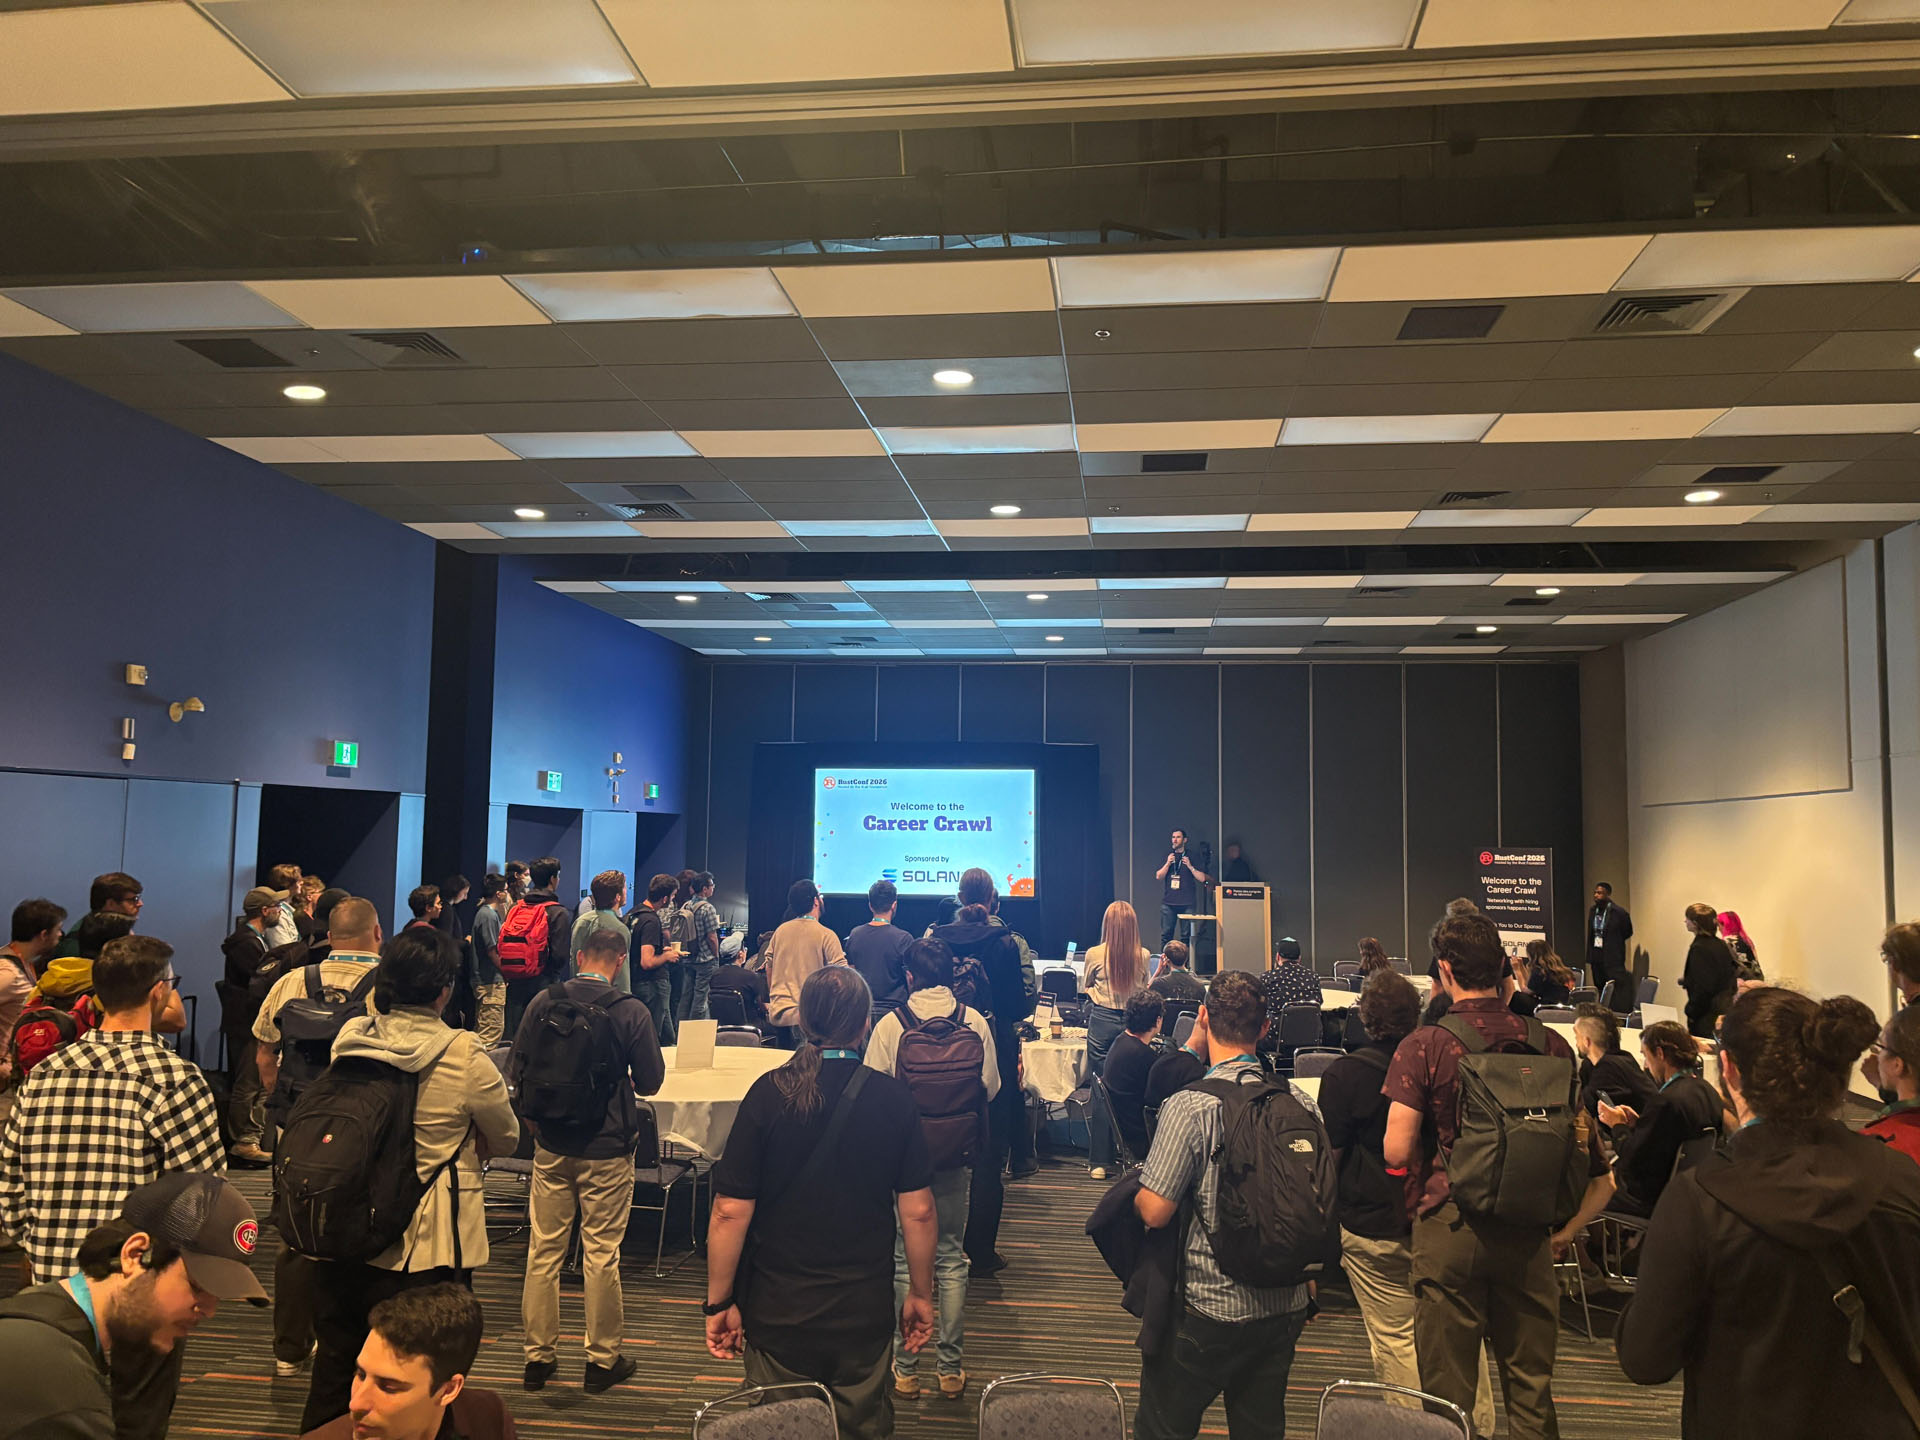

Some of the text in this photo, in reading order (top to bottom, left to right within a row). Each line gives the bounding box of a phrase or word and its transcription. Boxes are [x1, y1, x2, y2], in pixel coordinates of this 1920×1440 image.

[890, 802, 965, 811] Welcome to the
[863, 815, 993, 832] Career Crawl
[904, 855, 950, 864] Sponsored by
[902, 870, 961, 883] SOLAN
[1480, 876, 1542, 885] Welcome to the
[1486, 885, 1537, 895] Career Crawl
